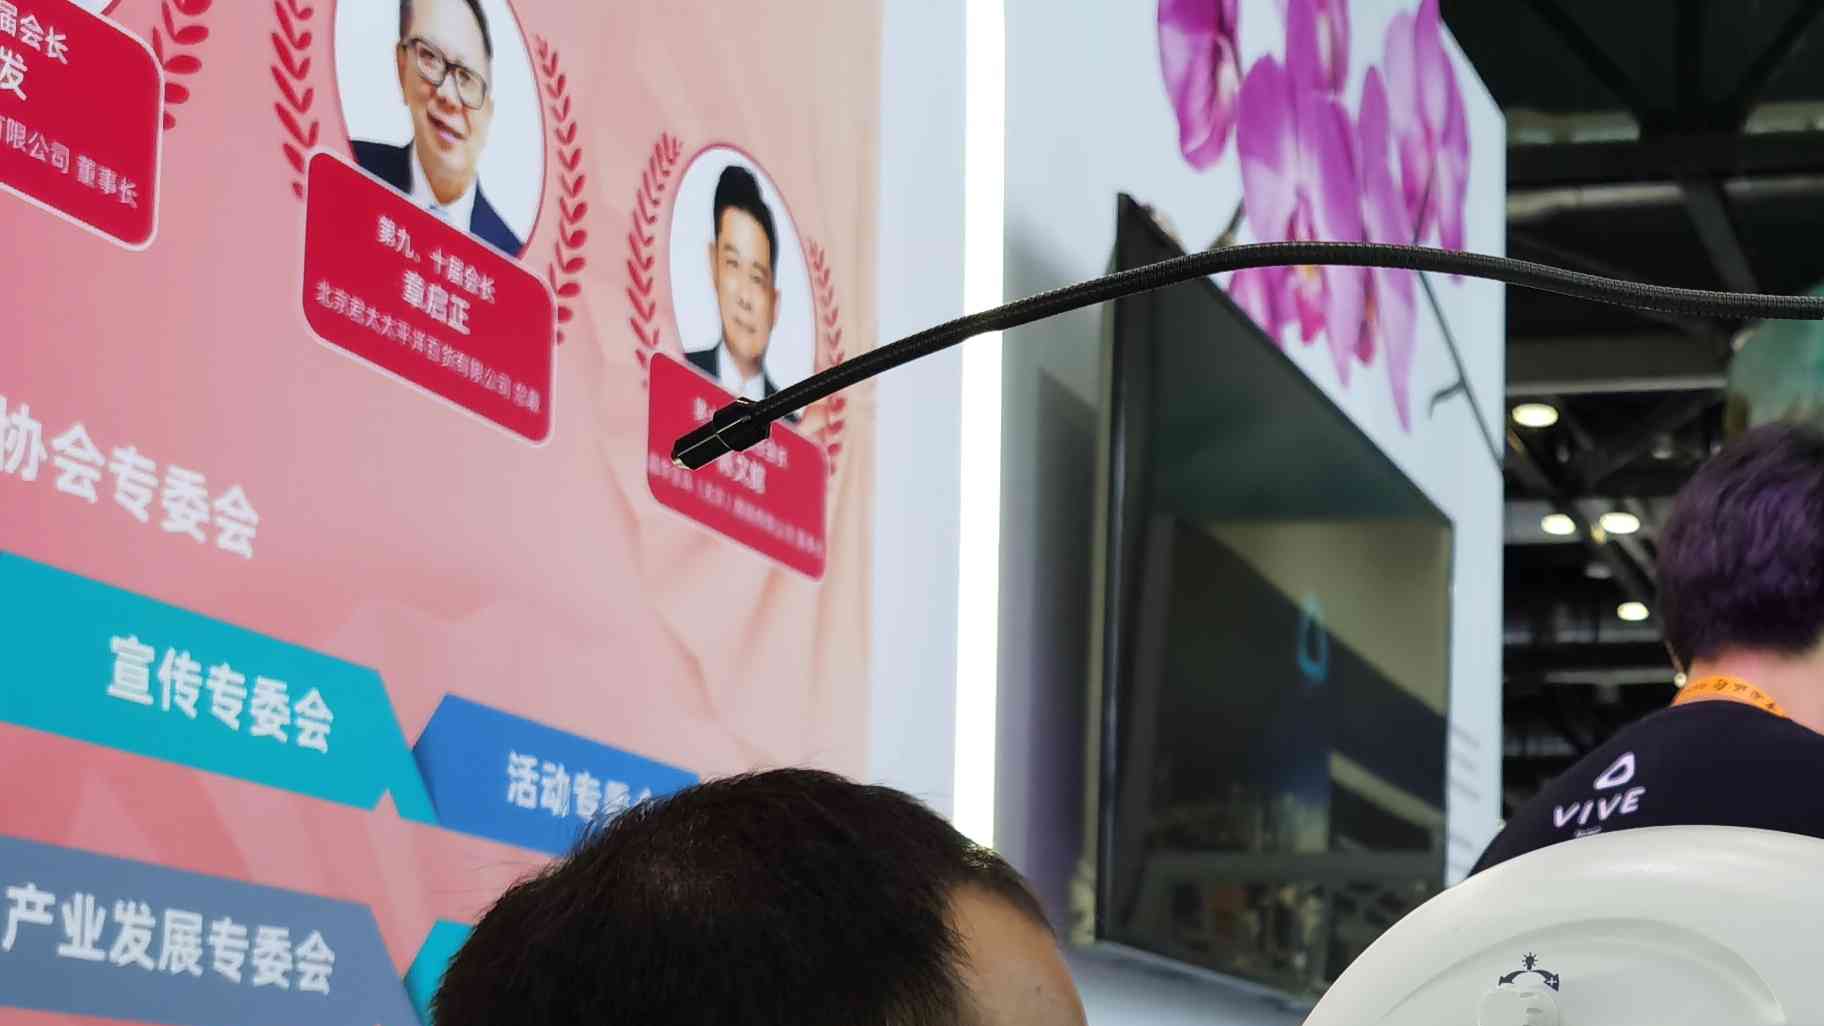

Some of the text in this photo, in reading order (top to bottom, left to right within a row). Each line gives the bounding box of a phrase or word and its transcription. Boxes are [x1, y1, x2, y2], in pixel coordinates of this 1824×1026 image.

[0, 393, 259, 560] 协会专委会
[107, 635, 334, 754] 宣传专委会
[507, 748, 655, 822] 活动专委
[1553, 785, 1646, 828] VIVE
[1, 882, 336, 996] 产业发展专委会
